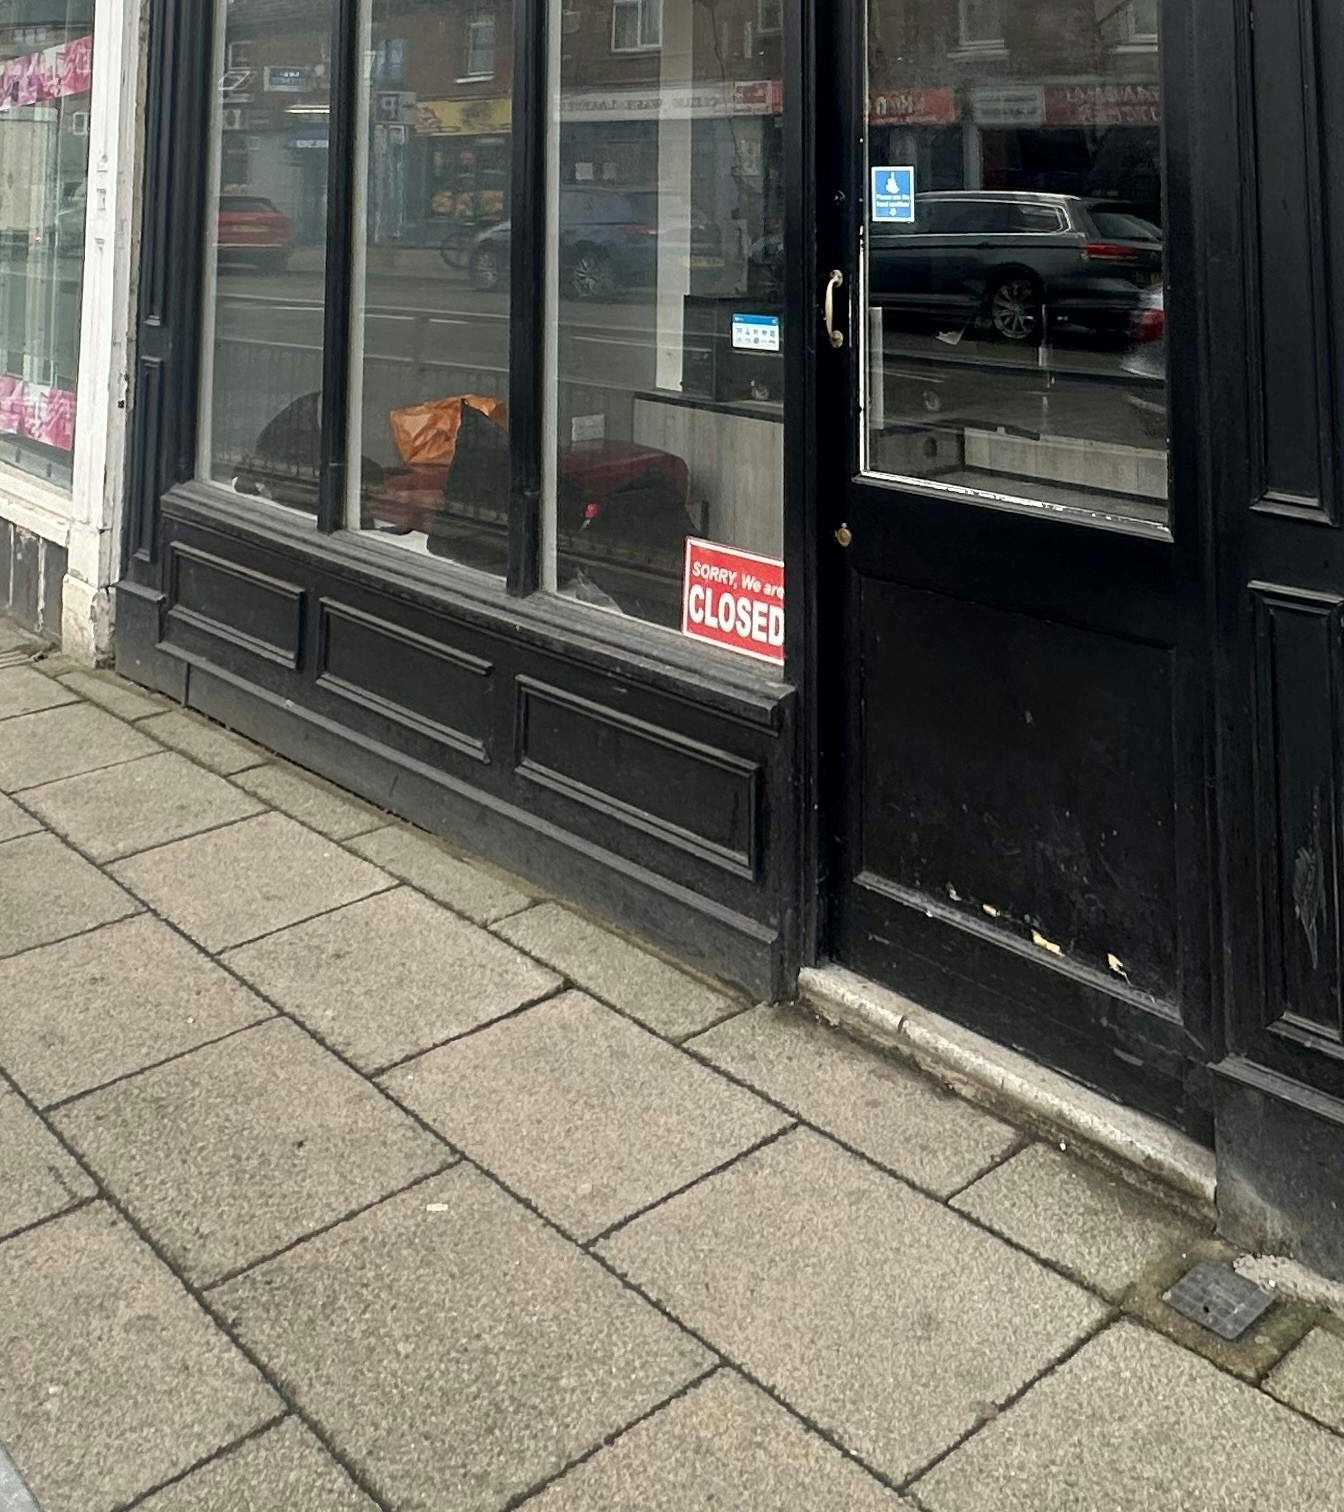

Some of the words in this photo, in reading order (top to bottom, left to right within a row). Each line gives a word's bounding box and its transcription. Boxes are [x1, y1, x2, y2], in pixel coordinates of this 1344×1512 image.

[692, 561, 738, 590] SORRY,
[741, 574, 762, 593] We
[763, 583, 785, 600] are
[689, 584, 785, 647] CLOSED
